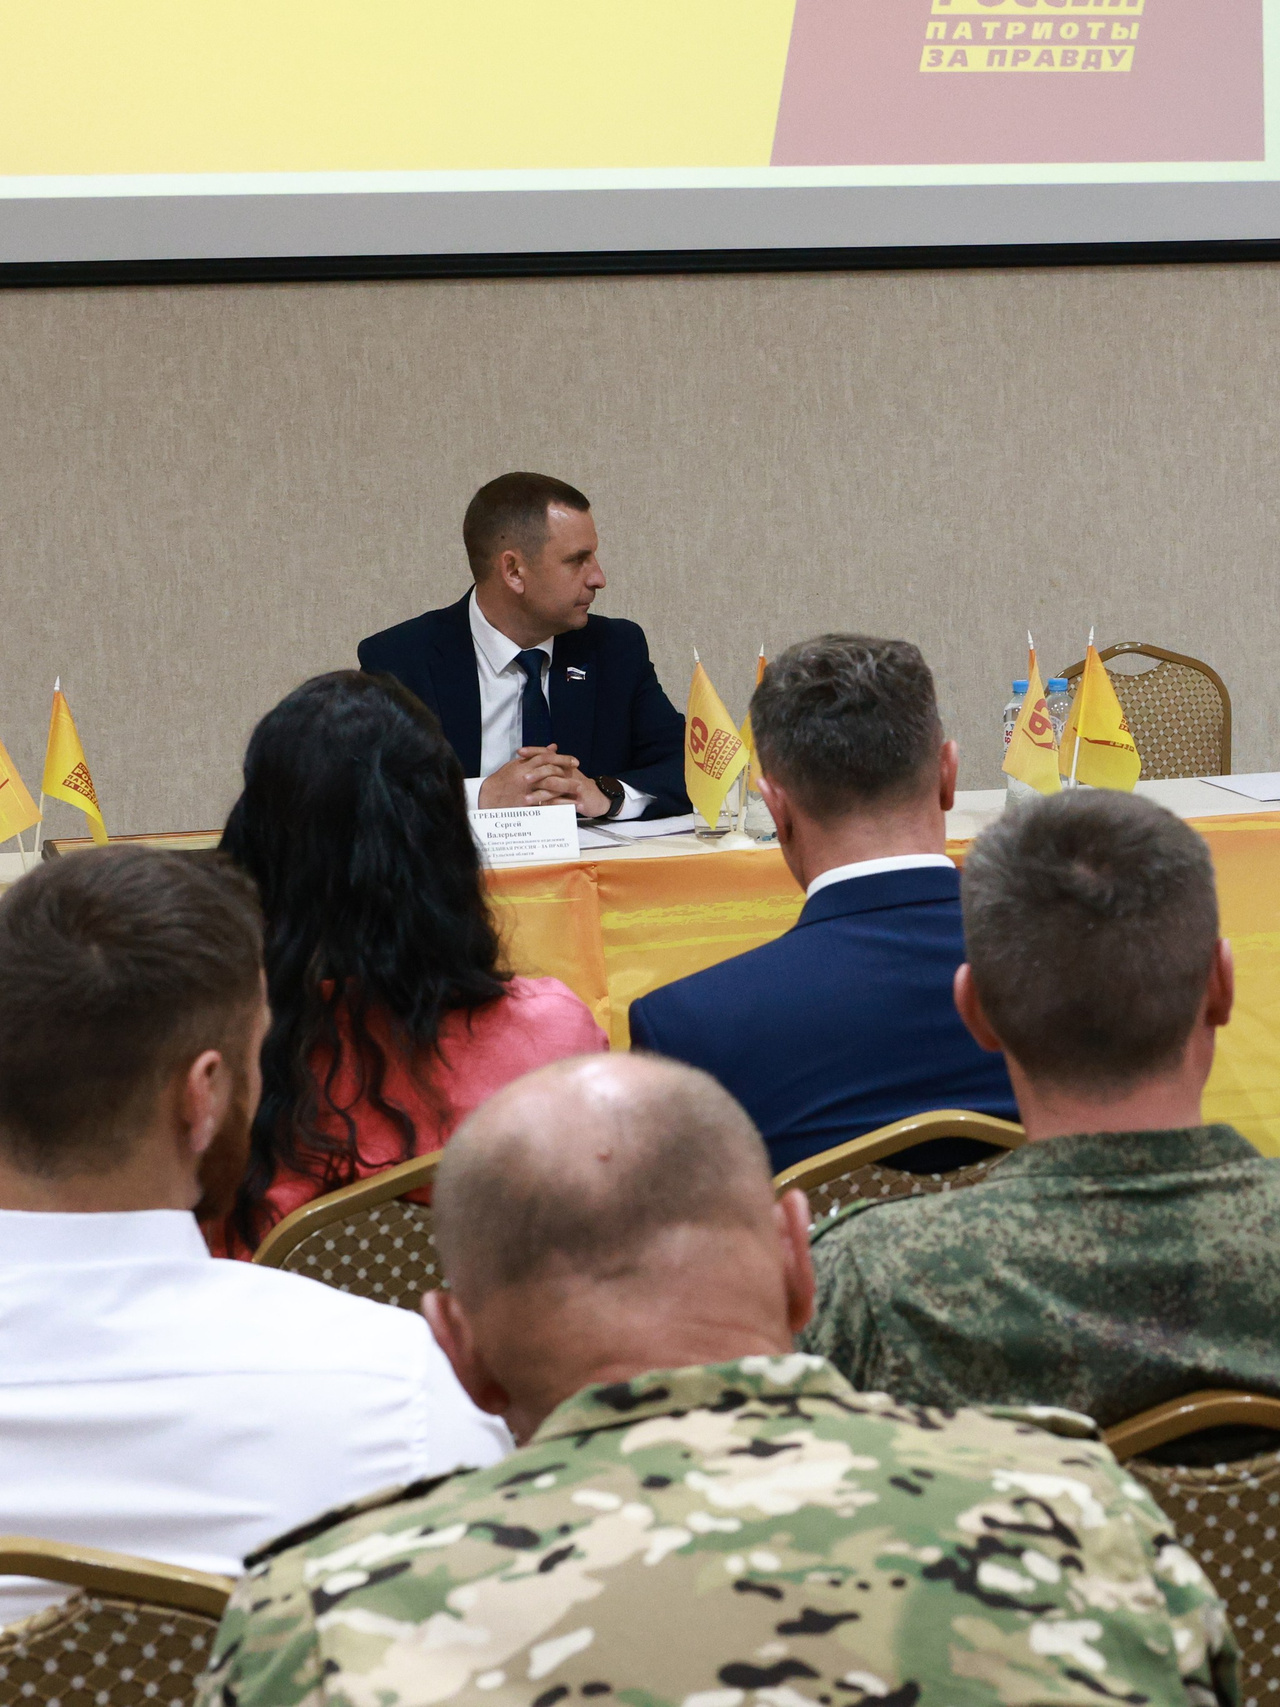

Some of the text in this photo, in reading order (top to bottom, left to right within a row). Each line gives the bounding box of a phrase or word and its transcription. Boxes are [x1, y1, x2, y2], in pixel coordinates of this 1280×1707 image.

[925, 21, 1140, 40] ПАТРИОТЫ
[926, 48, 1129, 70] ЗА ПРАВДУ
[473, 809, 541, 820] ГРЕБЕНЩИКОВ
[494, 821, 522, 829] Сергей
[486, 831, 532, 840] Валерьевич
